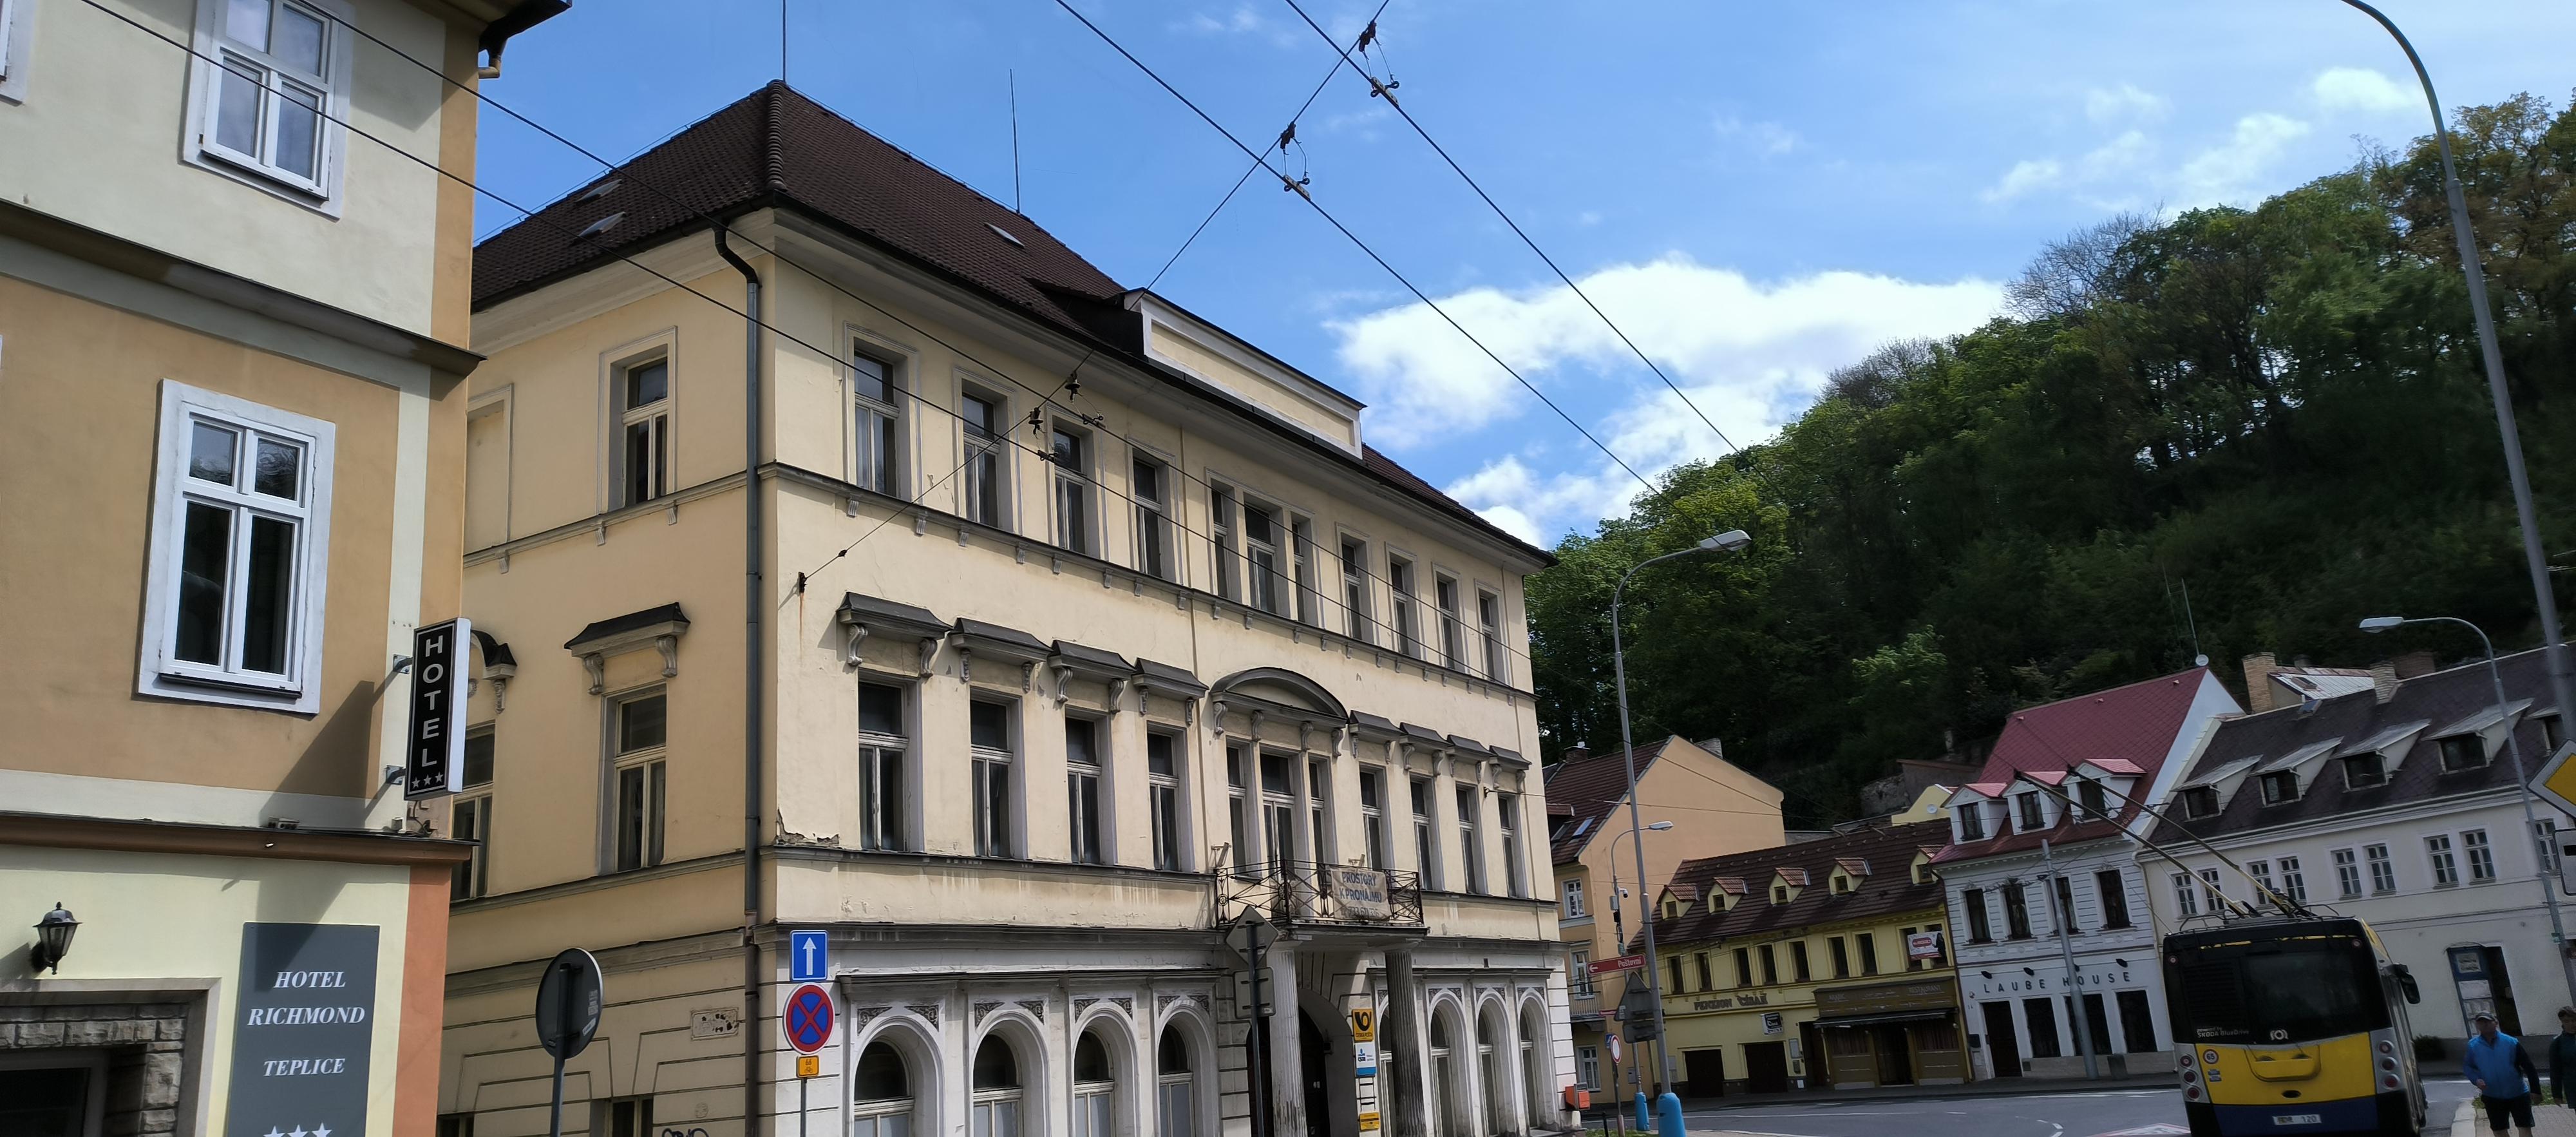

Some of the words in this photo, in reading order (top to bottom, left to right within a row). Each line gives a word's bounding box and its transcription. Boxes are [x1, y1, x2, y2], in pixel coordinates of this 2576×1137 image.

[422, 635, 444, 767] HOTEL
[1341, 872, 1376, 886] PROSTORY
[1339, 888, 1345, 899] K
[1345, 888, 1382, 903] PRONÁJMU
[1618, 957, 1642, 968] Poštovní
[273, 971, 346, 988] HOTEL
[1984, 979, 2046, 993] LAUBE
[2063, 971, 2130, 986] HOUSE
[247, 1007, 365, 1026] RICHMOND
[263, 1058, 346, 1076] TEPLICE
